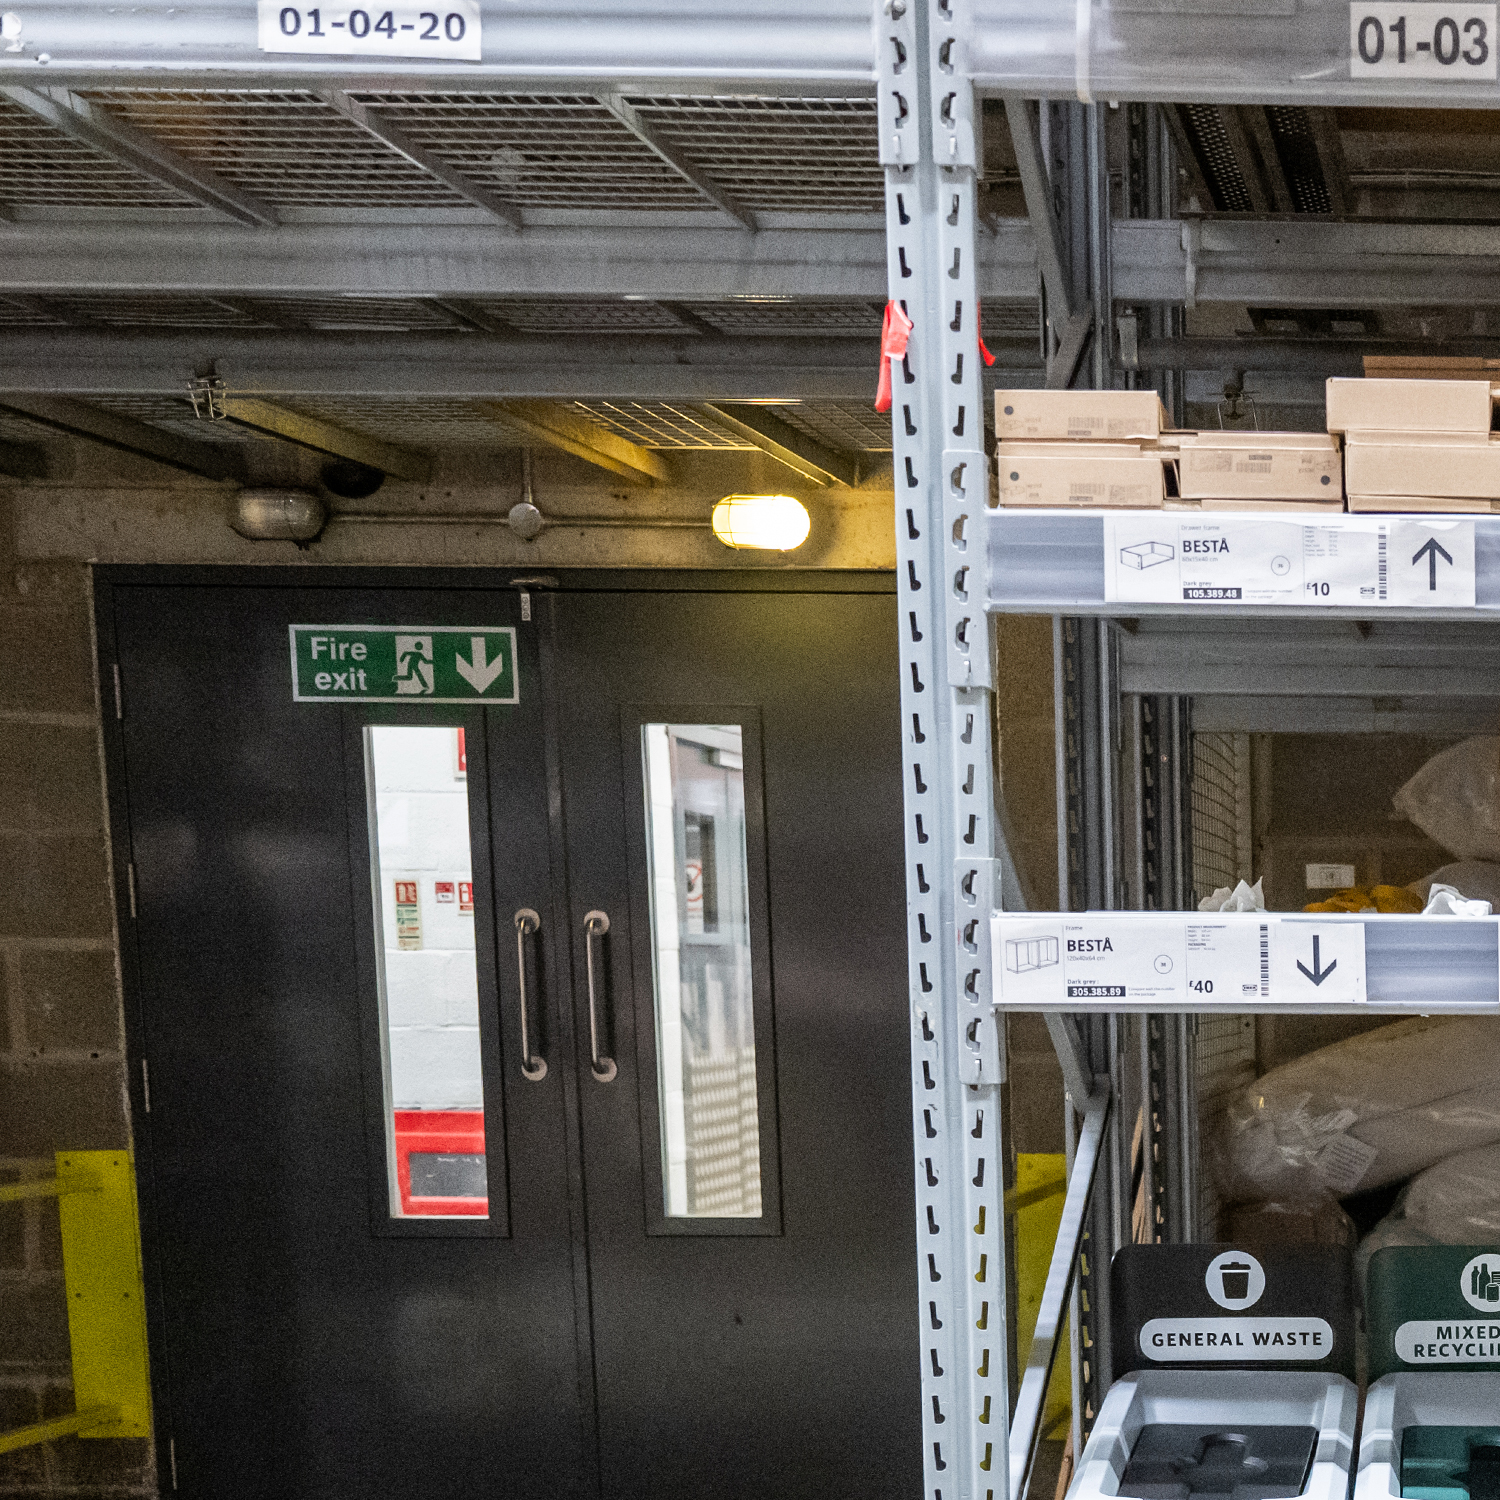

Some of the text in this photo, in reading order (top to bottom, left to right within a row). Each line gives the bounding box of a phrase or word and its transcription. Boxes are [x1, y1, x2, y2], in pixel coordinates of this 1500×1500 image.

[280, 8, 466, 42] 01-04-20
[1358, 16, 1489, 65] 01-03
[1183, 538, 1230, 553] BESTÅ
[1188, 590, 1237, 599] 105.389.48
[1307, 583, 1330, 596] £10
[311, 637, 367, 661] Fire
[314, 668, 367, 691] exit
[1068, 937, 1114, 952] BESTÅ
[1073, 988, 1122, 996] 305.385.89
[1189, 980, 1214, 993] £40
[1152, 1332, 1323, 1348] GENERAL WASTE
